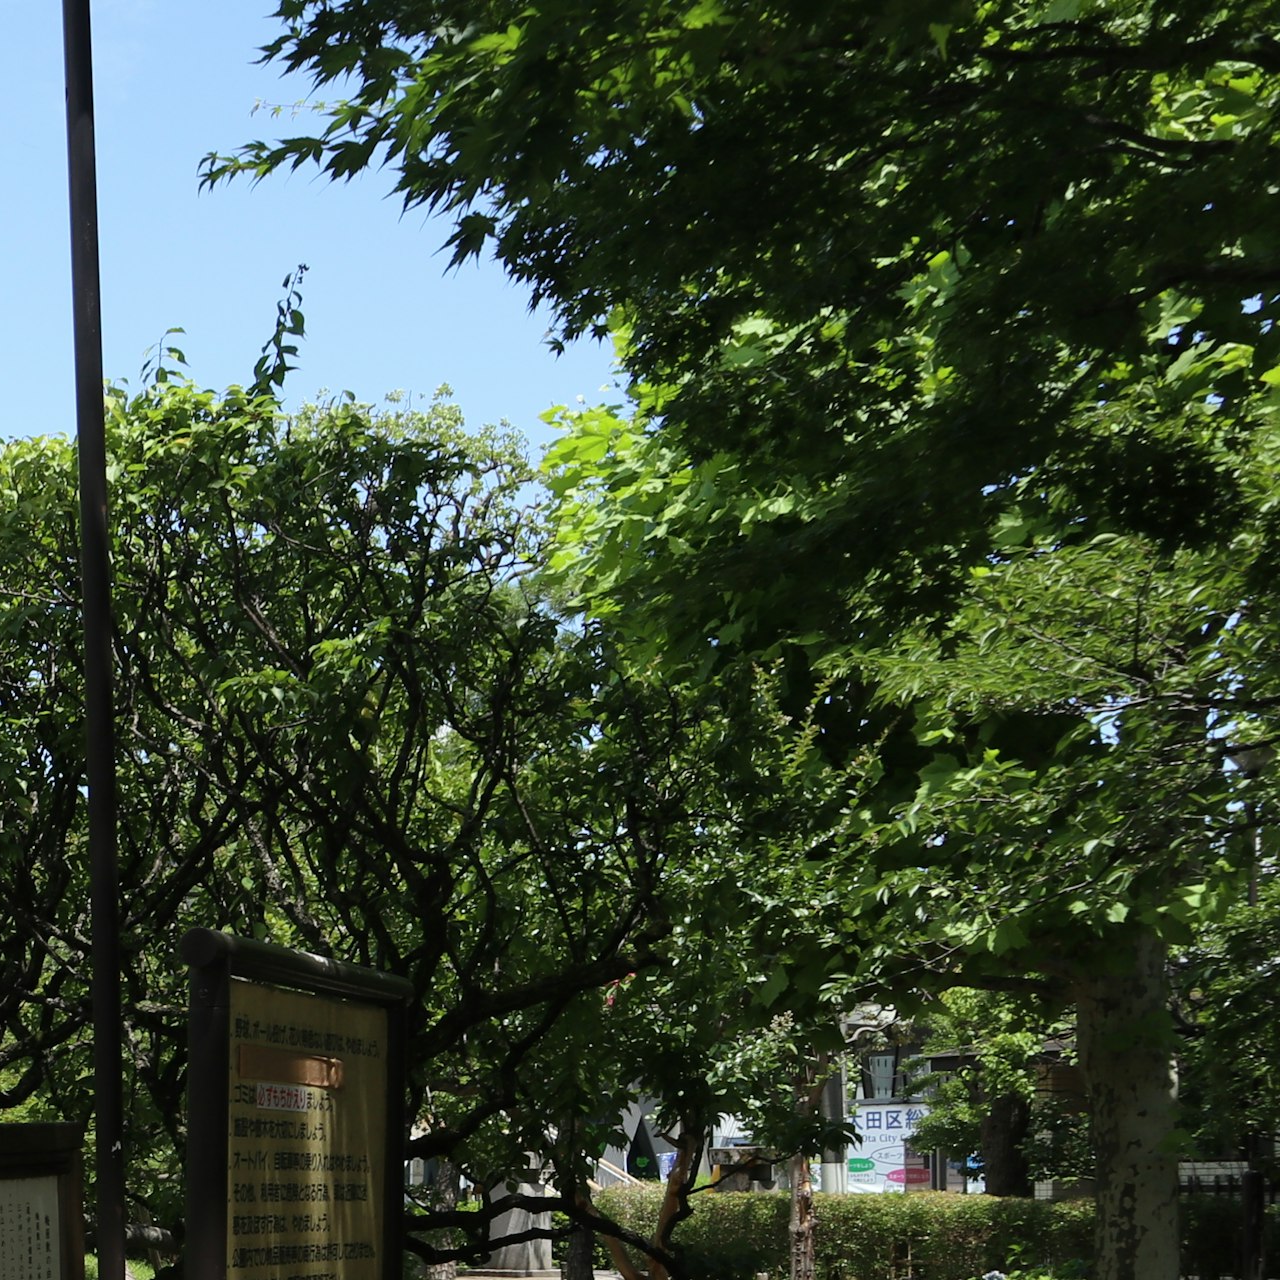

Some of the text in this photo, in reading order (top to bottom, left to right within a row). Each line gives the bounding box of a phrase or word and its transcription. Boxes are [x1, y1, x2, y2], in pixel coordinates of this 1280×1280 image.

[847, 1108, 927, 1131] 大田区総
[879, 1133, 897, 1145] City
